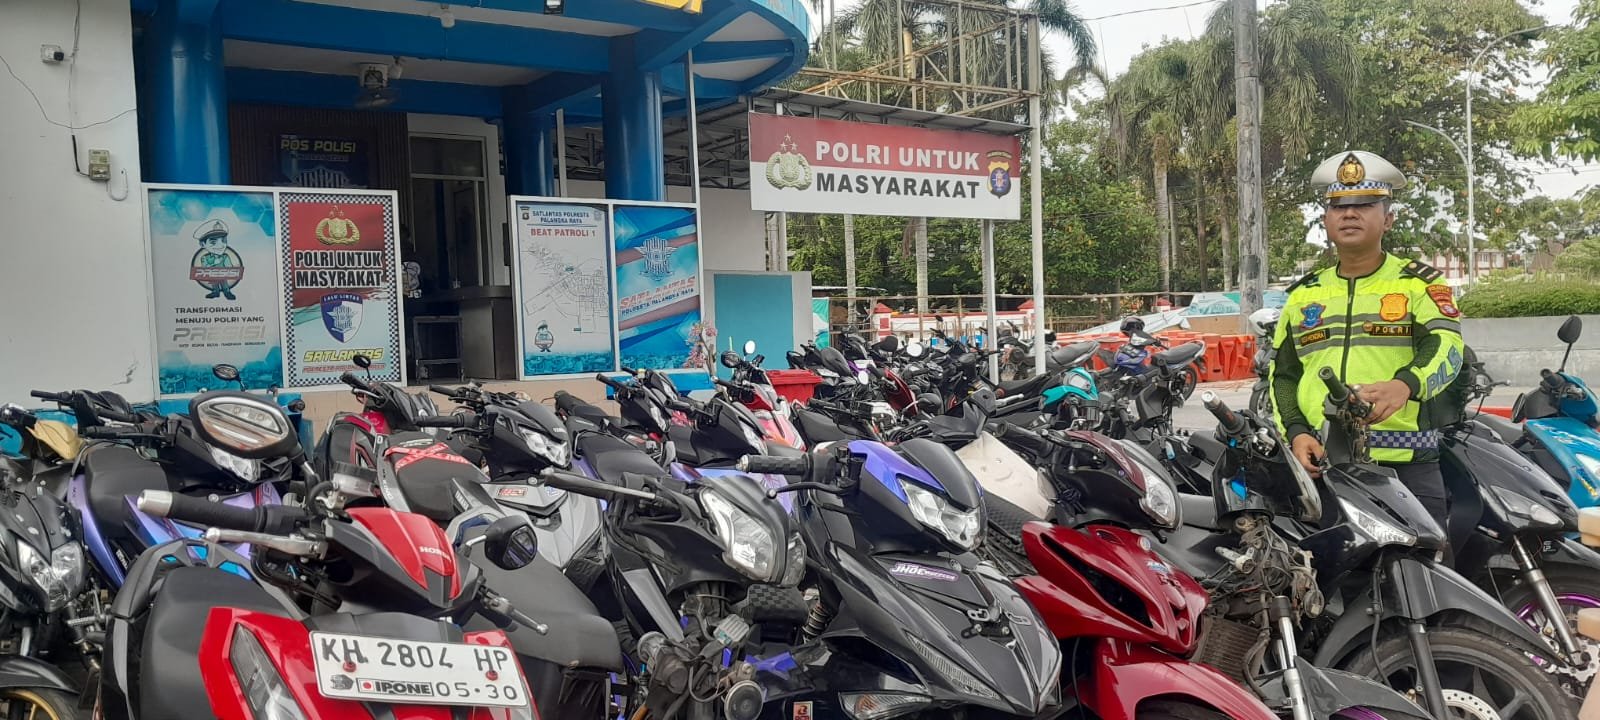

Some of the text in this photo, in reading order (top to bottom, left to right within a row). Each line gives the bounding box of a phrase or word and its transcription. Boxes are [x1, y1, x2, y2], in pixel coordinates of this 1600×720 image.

[281, 139, 356, 153] POS POLISI
[815, 140, 980, 170] POLRI UNTUK
[815, 172, 980, 199] MASYARAKAT
[531, 228, 553, 236] BEAT
[554, 229, 589, 237] PATROLI
[294, 250, 383, 268] POLRI UNTUK
[295, 269, 383, 288] MASYRAKAT
[175, 306, 243, 314] TRANSFORMASI
[1375, 325, 1409, 334] POLRI
[377, 641, 454, 668] 2804
[473, 648, 509, 673] HP
[375, 680, 432, 696] IPONE
